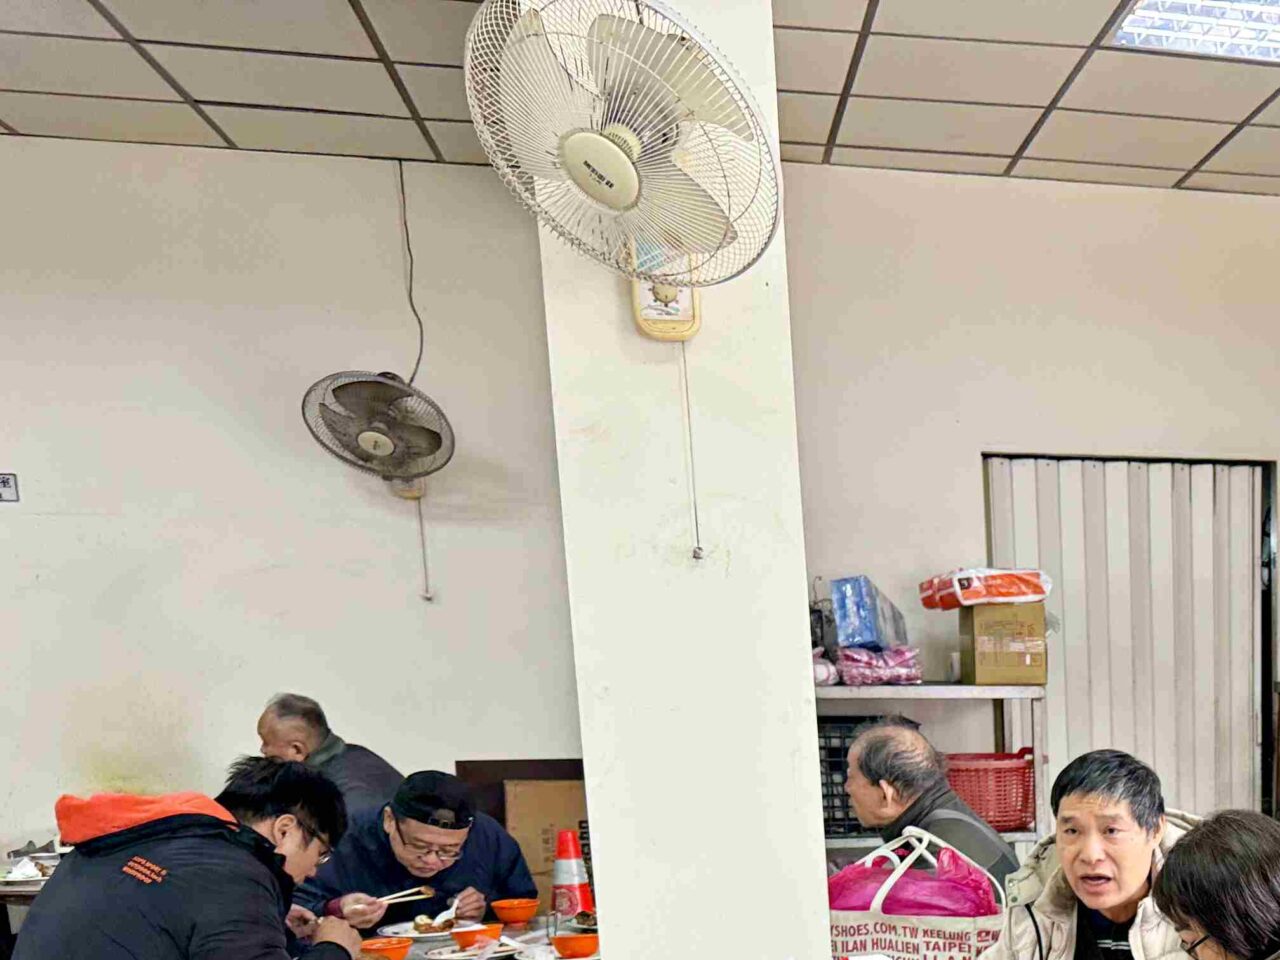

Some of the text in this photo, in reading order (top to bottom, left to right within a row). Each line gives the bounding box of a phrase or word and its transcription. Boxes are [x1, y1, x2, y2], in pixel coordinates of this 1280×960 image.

[922, 928, 971, 942] KEELUNG
[841, 939, 867, 953] ILAN
[872, 937, 919, 955] HUALIEN
[923, 940, 971, 954] TAIPEI
